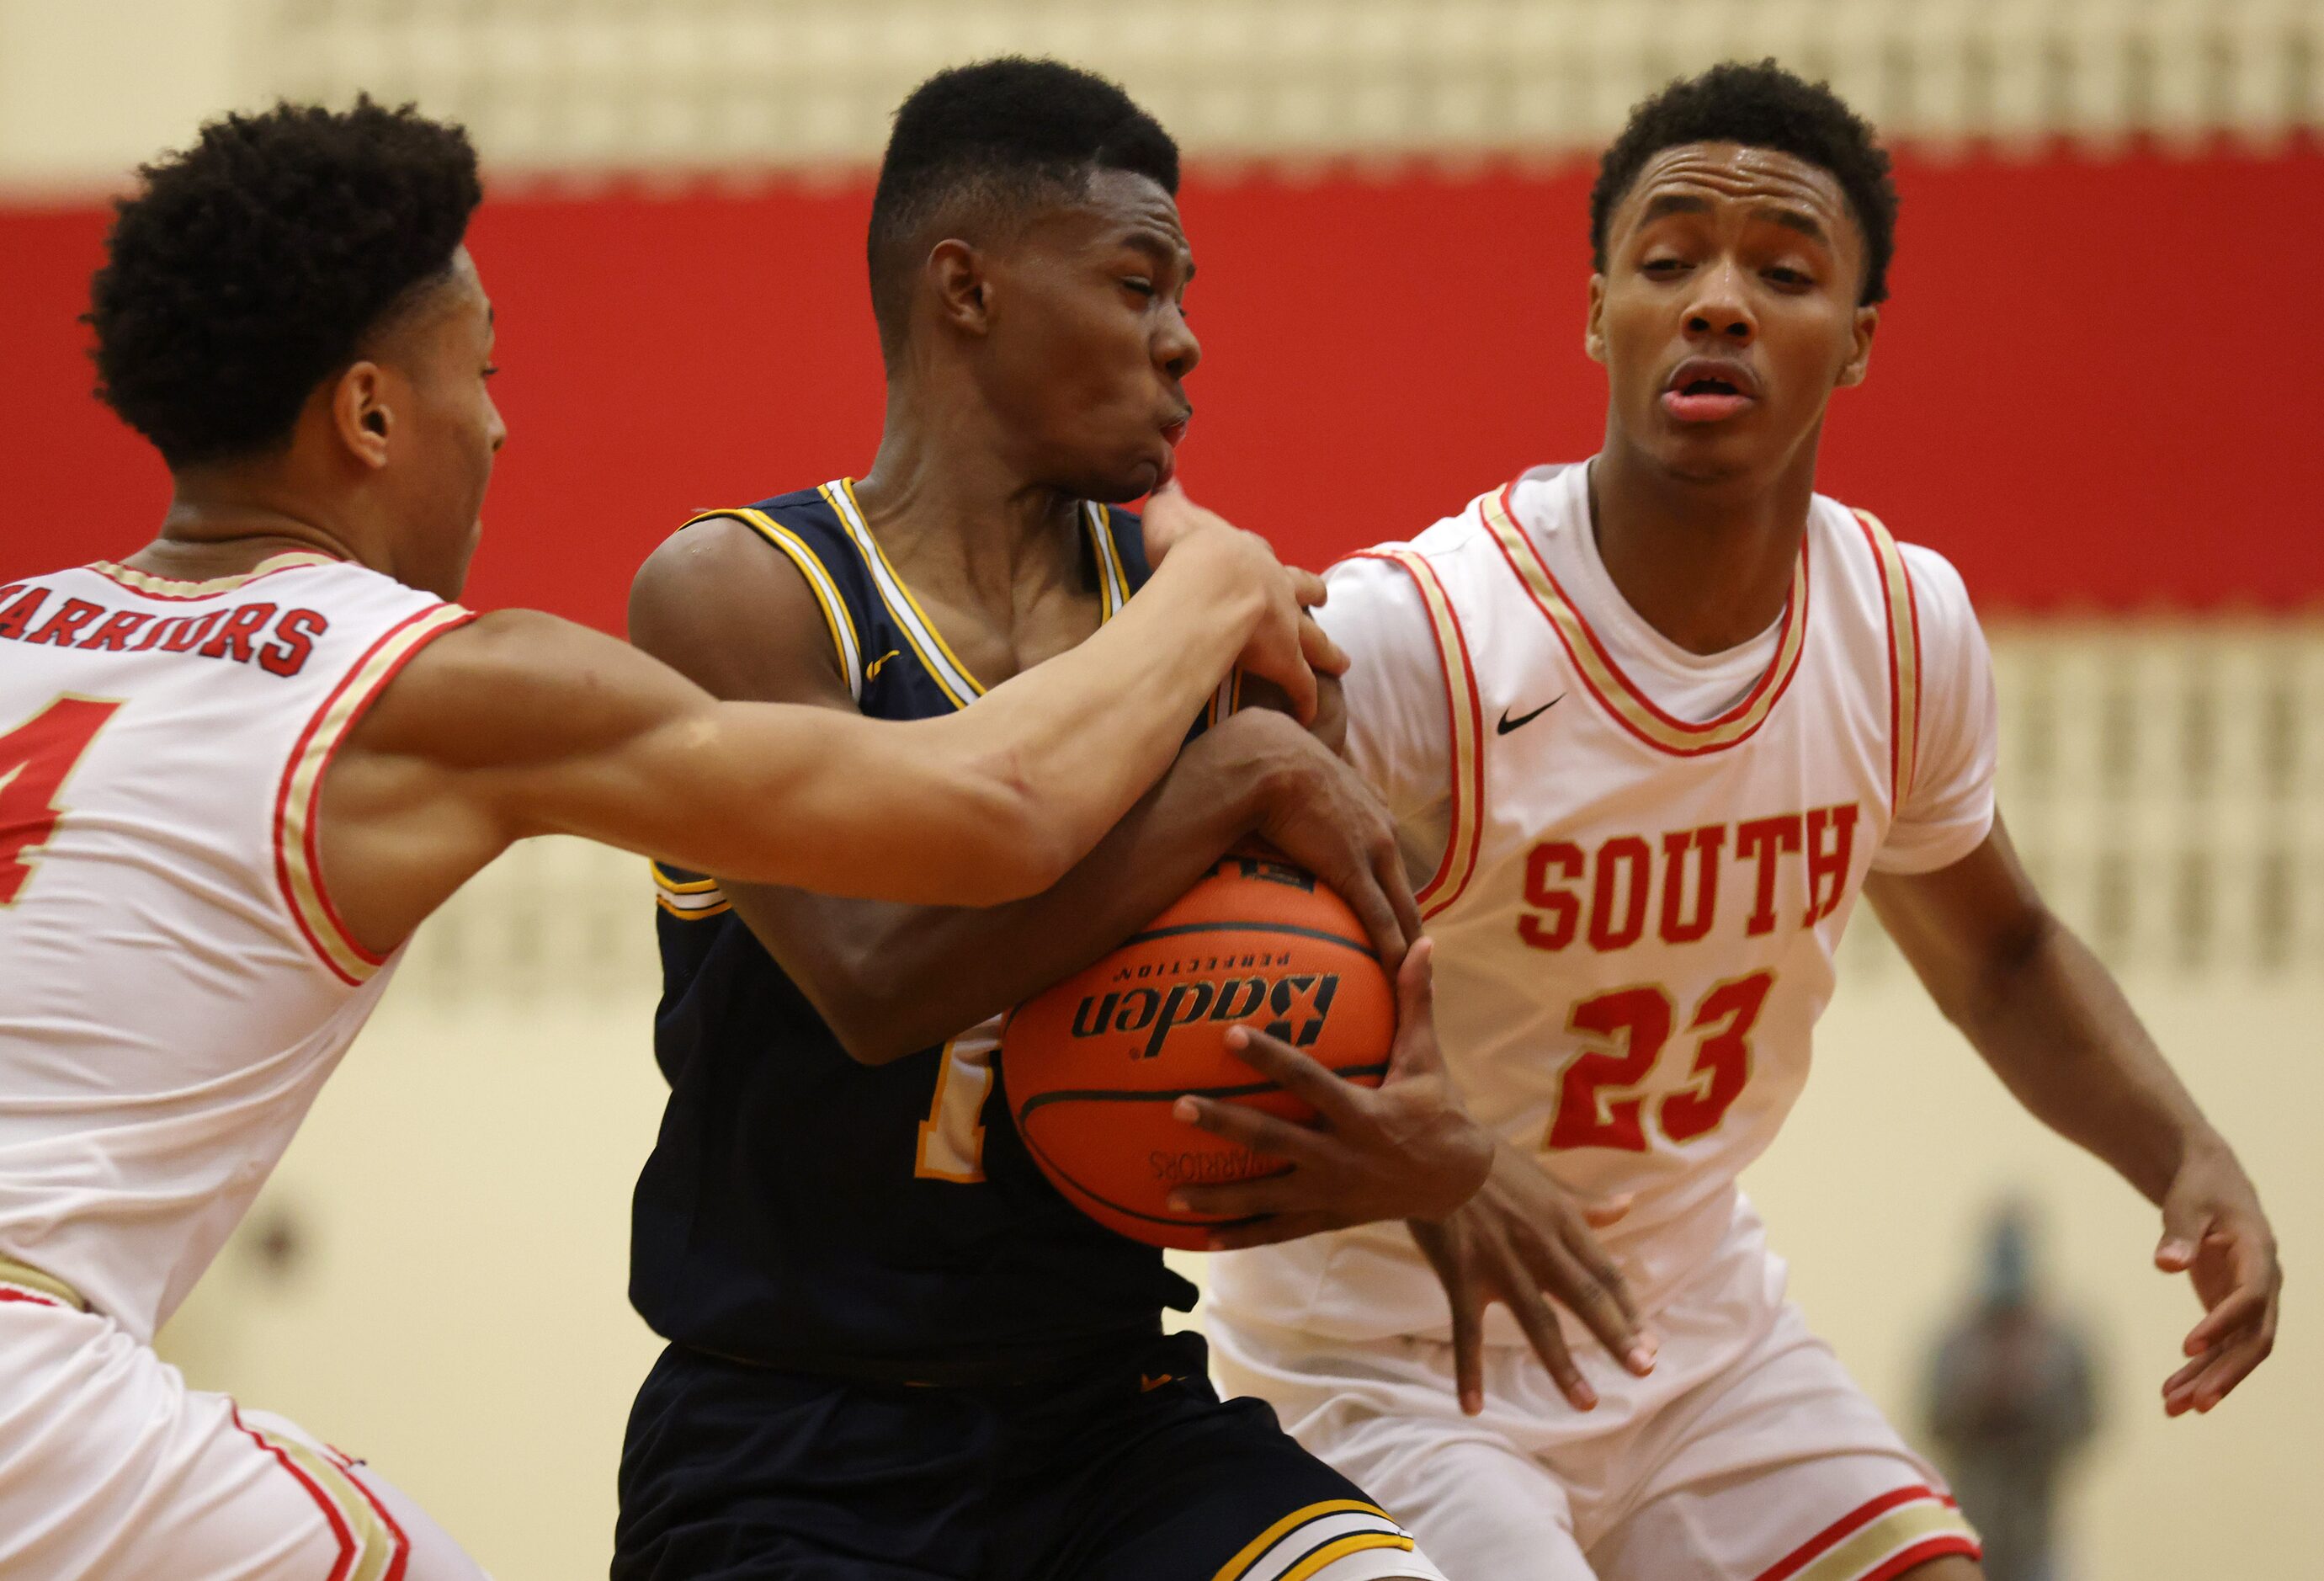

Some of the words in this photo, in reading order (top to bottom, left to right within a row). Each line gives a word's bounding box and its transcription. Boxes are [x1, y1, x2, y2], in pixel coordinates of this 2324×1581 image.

[0, 585, 328, 677] ARRIORS
[1518, 803, 1859, 952] SOUTH
[1114, 952, 1290, 981] PERFECTION
[1543, 966, 1778, 1152] 23
